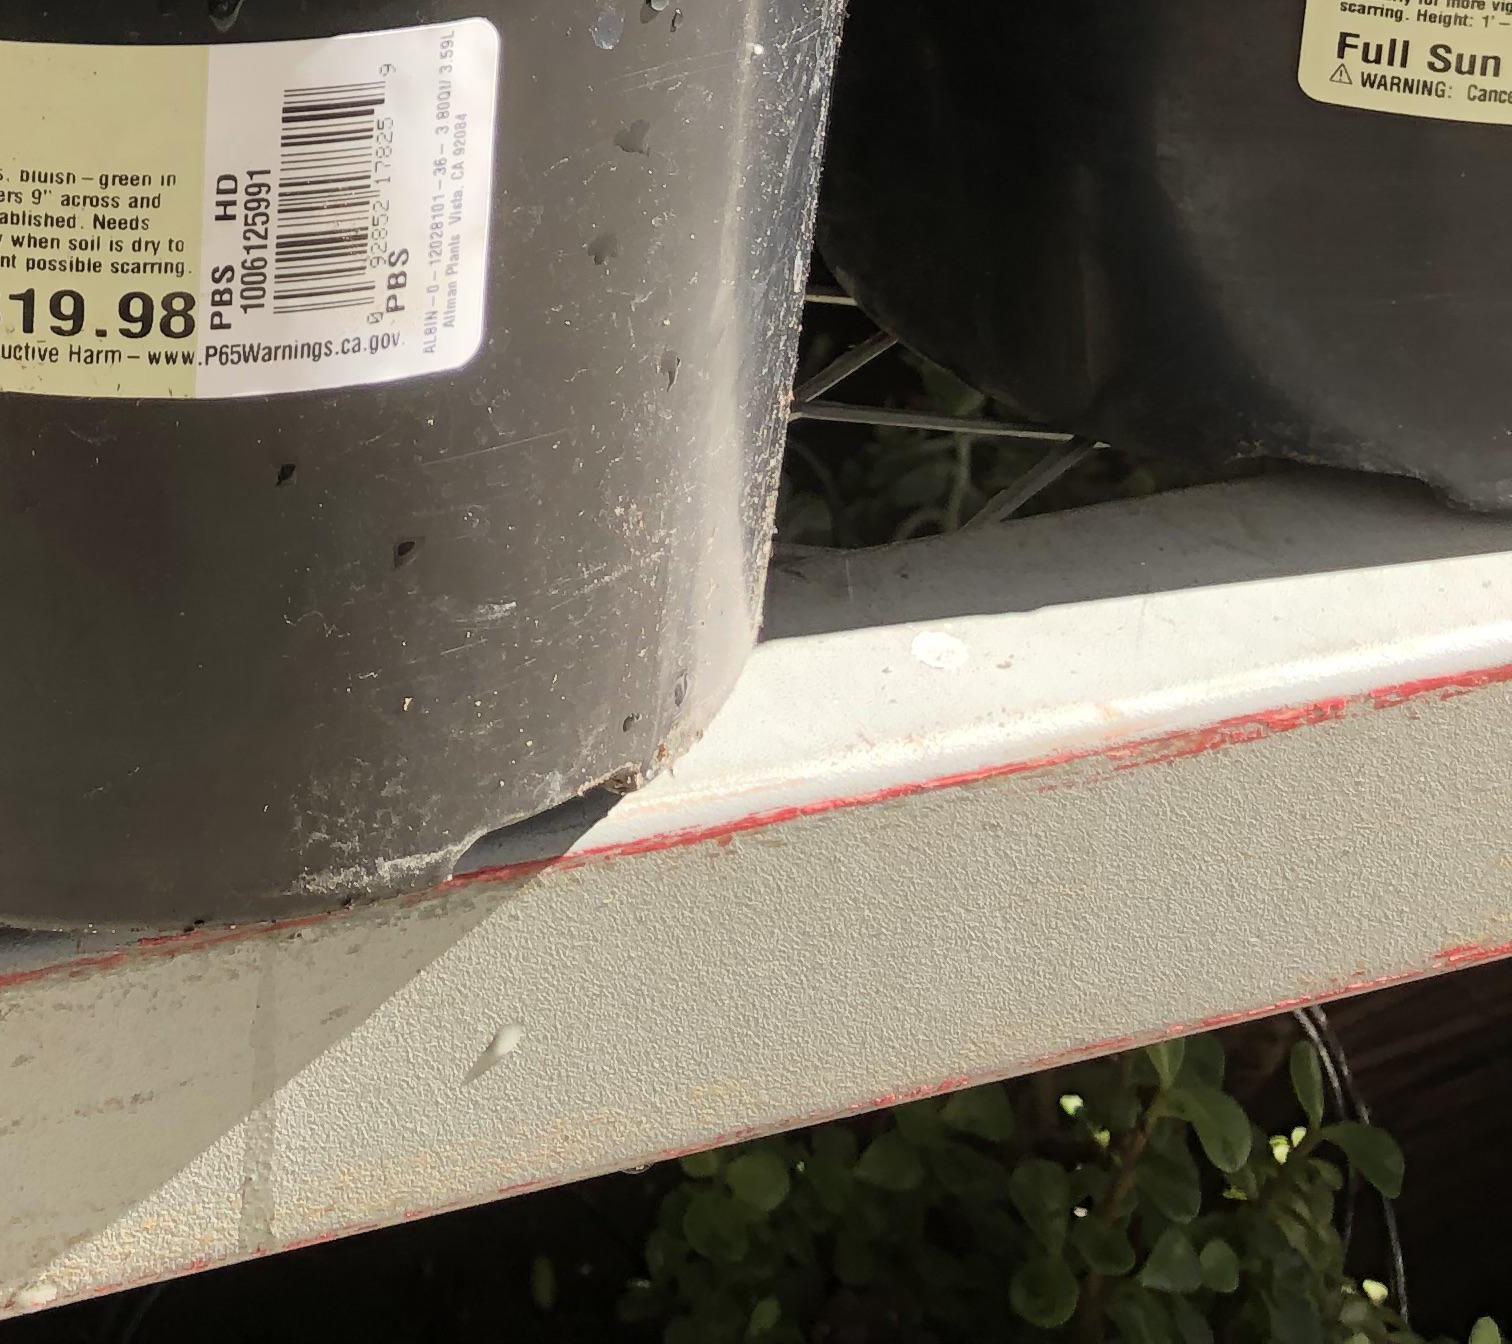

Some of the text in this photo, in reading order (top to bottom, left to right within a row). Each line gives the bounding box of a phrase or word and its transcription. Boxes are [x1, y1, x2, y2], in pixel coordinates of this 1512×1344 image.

[1339, 0, 1410, 23] scarring.
[1416, 8, 1474, 28] Height:
[1336, 31, 1502, 78] Full Sun
[1360, 70, 1453, 99] WARNING:
[160, 173, 177, 187] in
[60, 193, 120, 209] across
[128, 192, 161, 209] and
[92, 213, 150, 231] Needs
[11, 232, 61, 250] when
[68, 235, 101, 252] soil
[109, 238, 124, 253] is
[131, 237, 161, 256] dry
[167, 238, 185, 253] to
[209, 173, 238, 330] PBS HD
[239, 168, 272, 315] 1006125991
[25, 255, 103, 274] possible
[385, 247, 410, 313] PBS
